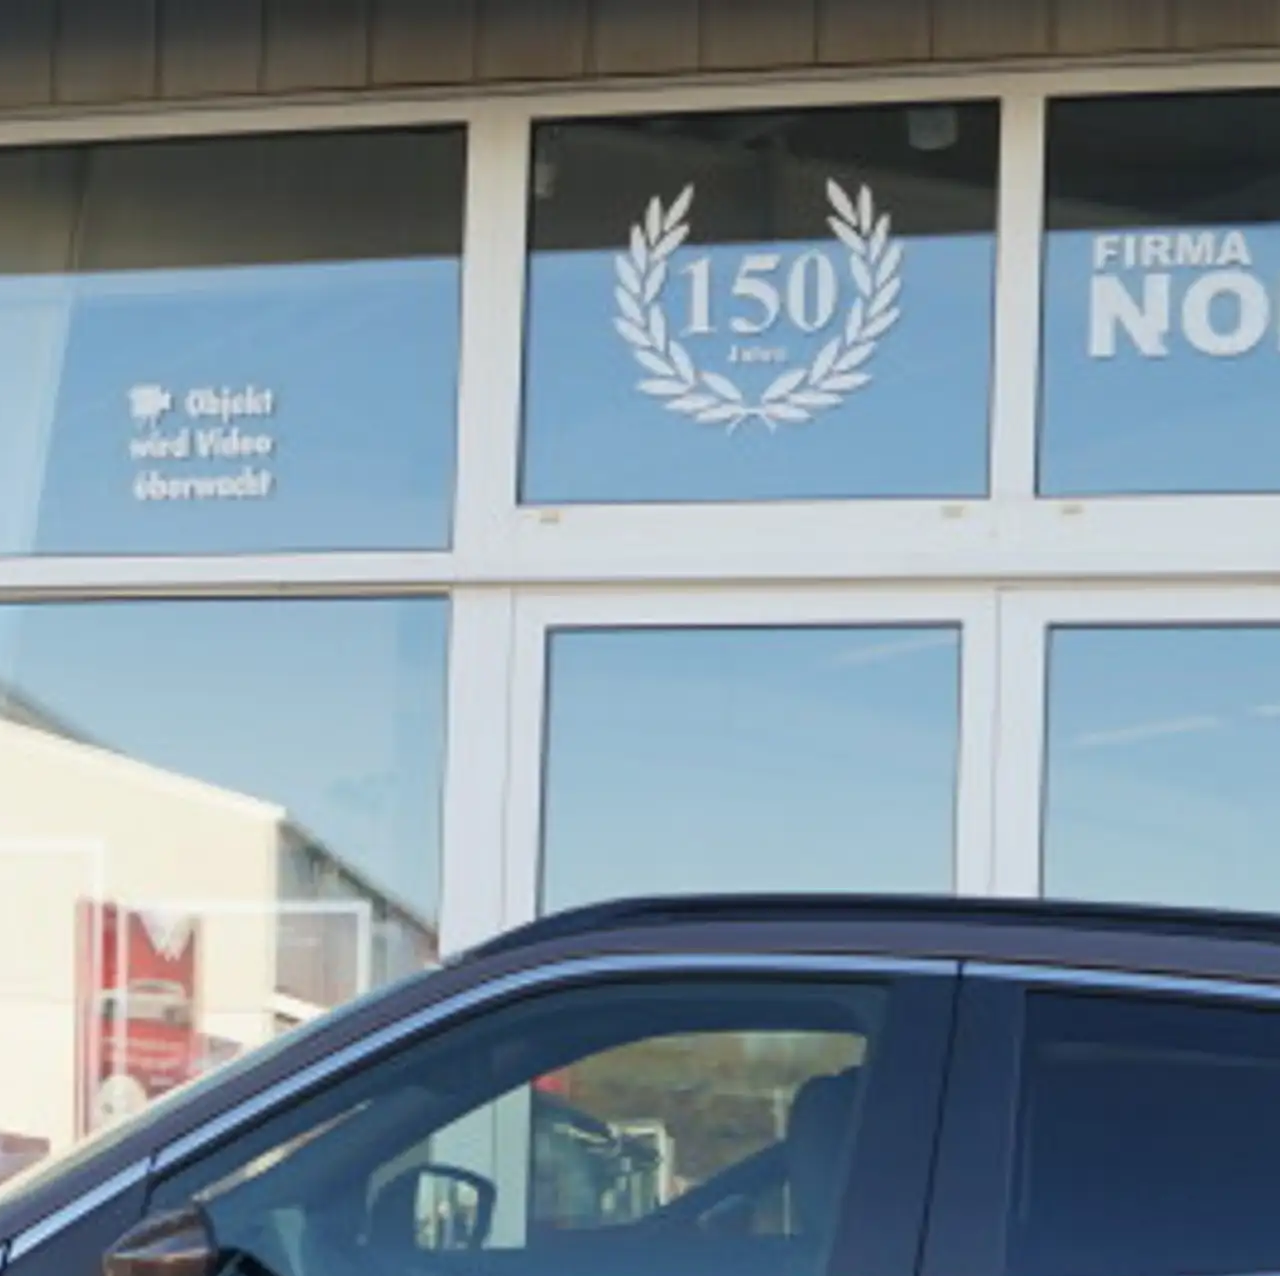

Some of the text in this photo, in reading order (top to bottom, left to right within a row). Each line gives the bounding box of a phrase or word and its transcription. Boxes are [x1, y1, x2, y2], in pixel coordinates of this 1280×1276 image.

[1094, 230, 1253, 268] FIRMA
[678, 249, 839, 338] 150
[183, 384, 274, 424] Objekt
[128, 426, 273, 459] wird Video
[132, 467, 274, 500] überwacht
